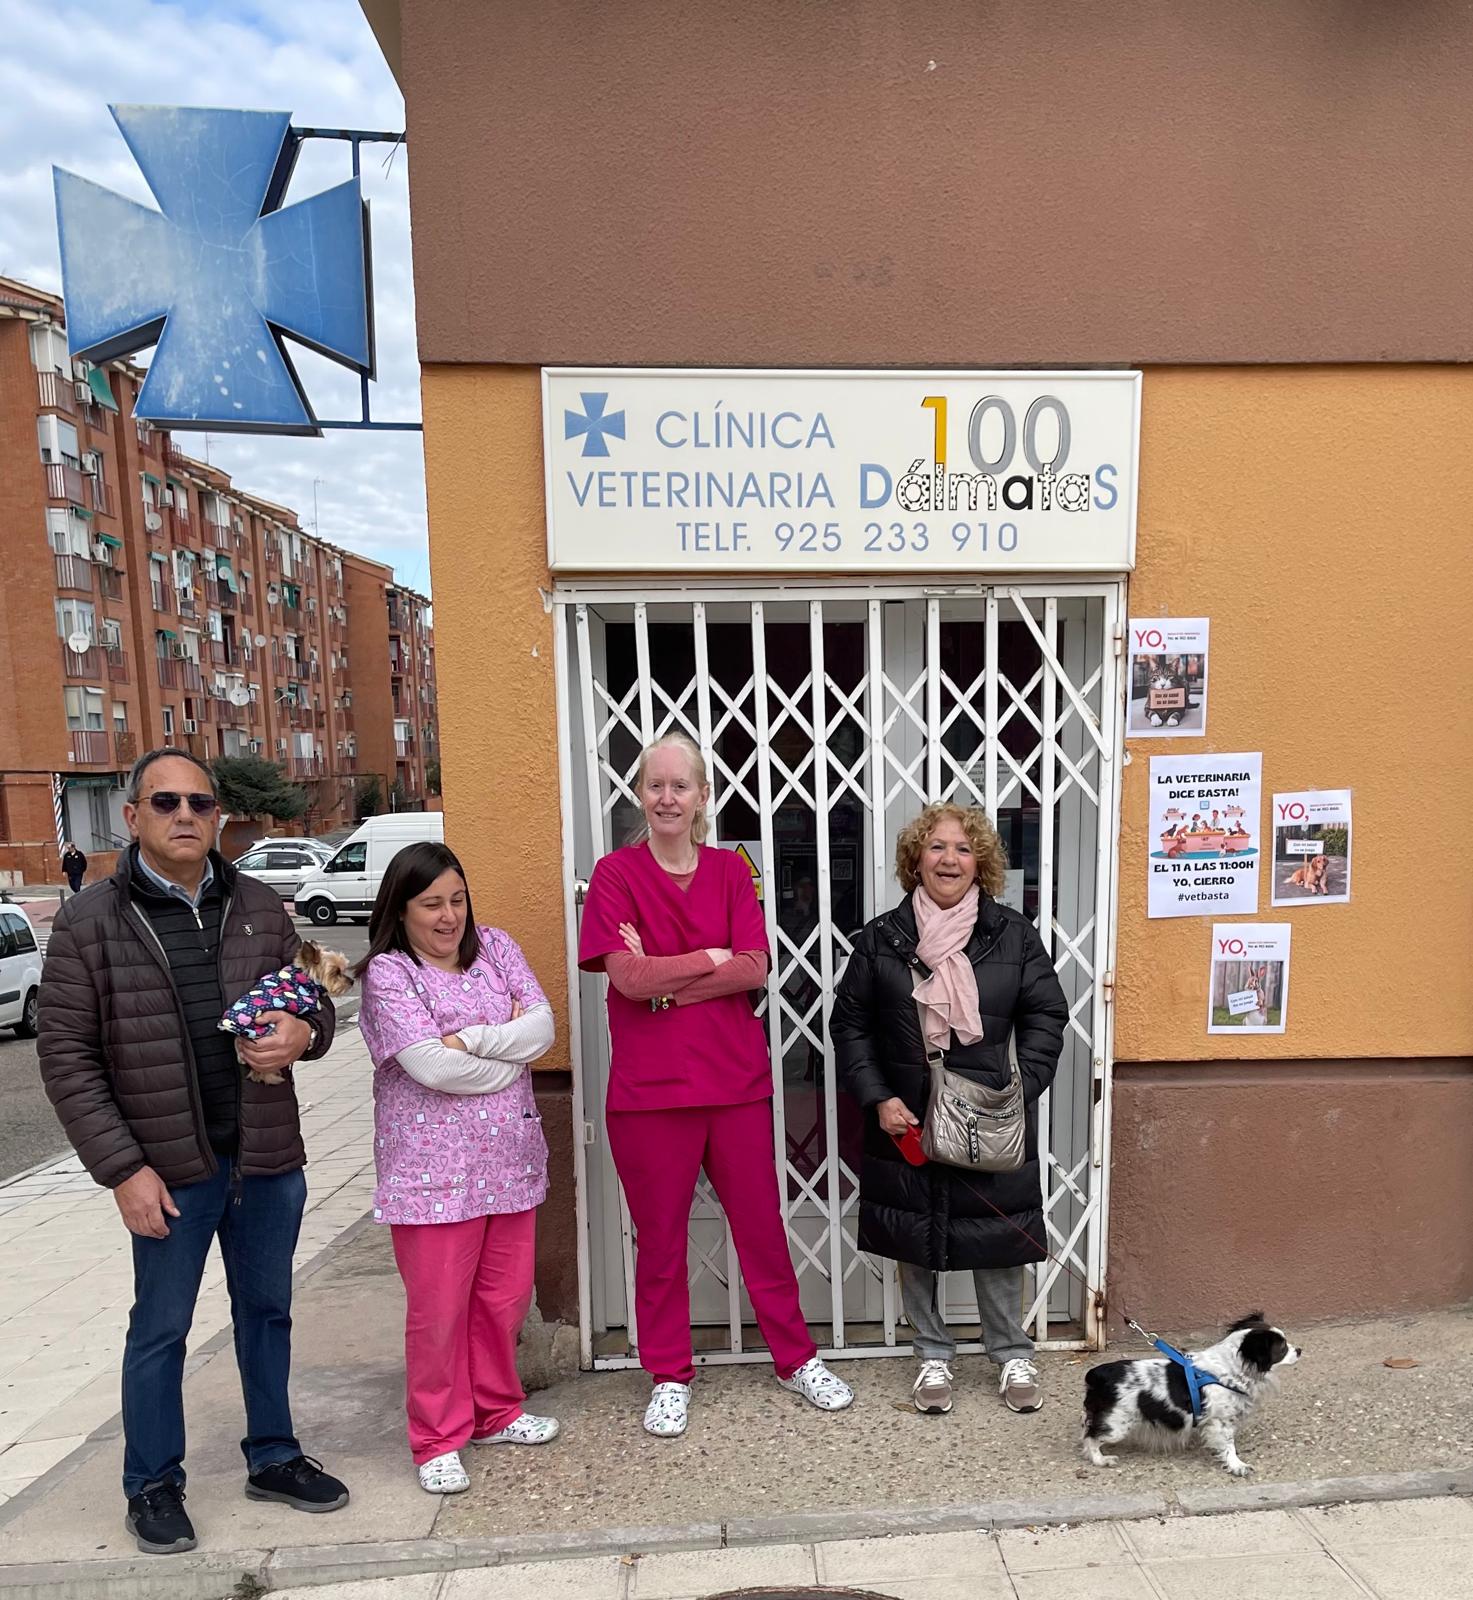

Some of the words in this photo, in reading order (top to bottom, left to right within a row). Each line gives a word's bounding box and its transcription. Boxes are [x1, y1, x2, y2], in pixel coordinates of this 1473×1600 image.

[656, 399, 836, 449] CLÍNICA
[920, 394, 1072, 475] 100
[566, 470, 836, 509] VETERINARIA
[676, 522, 751, 552] TELF.
[774, 522, 842, 552] 925
[863, 522, 930, 552] 233
[951, 522, 1018, 552] 910
[1135, 630, 1167, 651] YO,
[1158, 776, 1173, 785] LA
[1176, 772, 1251, 784] VETERINARIA
[1169, 789, 1195, 799] DICE
[1198, 788, 1239, 798] BASTA!
[1278, 803, 1309, 822] YO,
[1154, 864, 1169, 873] EL
[1172, 863, 1181, 872] 11
[1183, 863, 1191, 872] A
[1194, 862, 1217, 871] LAS
[1220, 860, 1254, 870] 11:00H
[1173, 878, 1191, 887] YO,
[1194, 876, 1235, 886] CIERRO
[1178, 892, 1230, 902] #vetbasta
[1218, 939, 1247, 958] YO,
